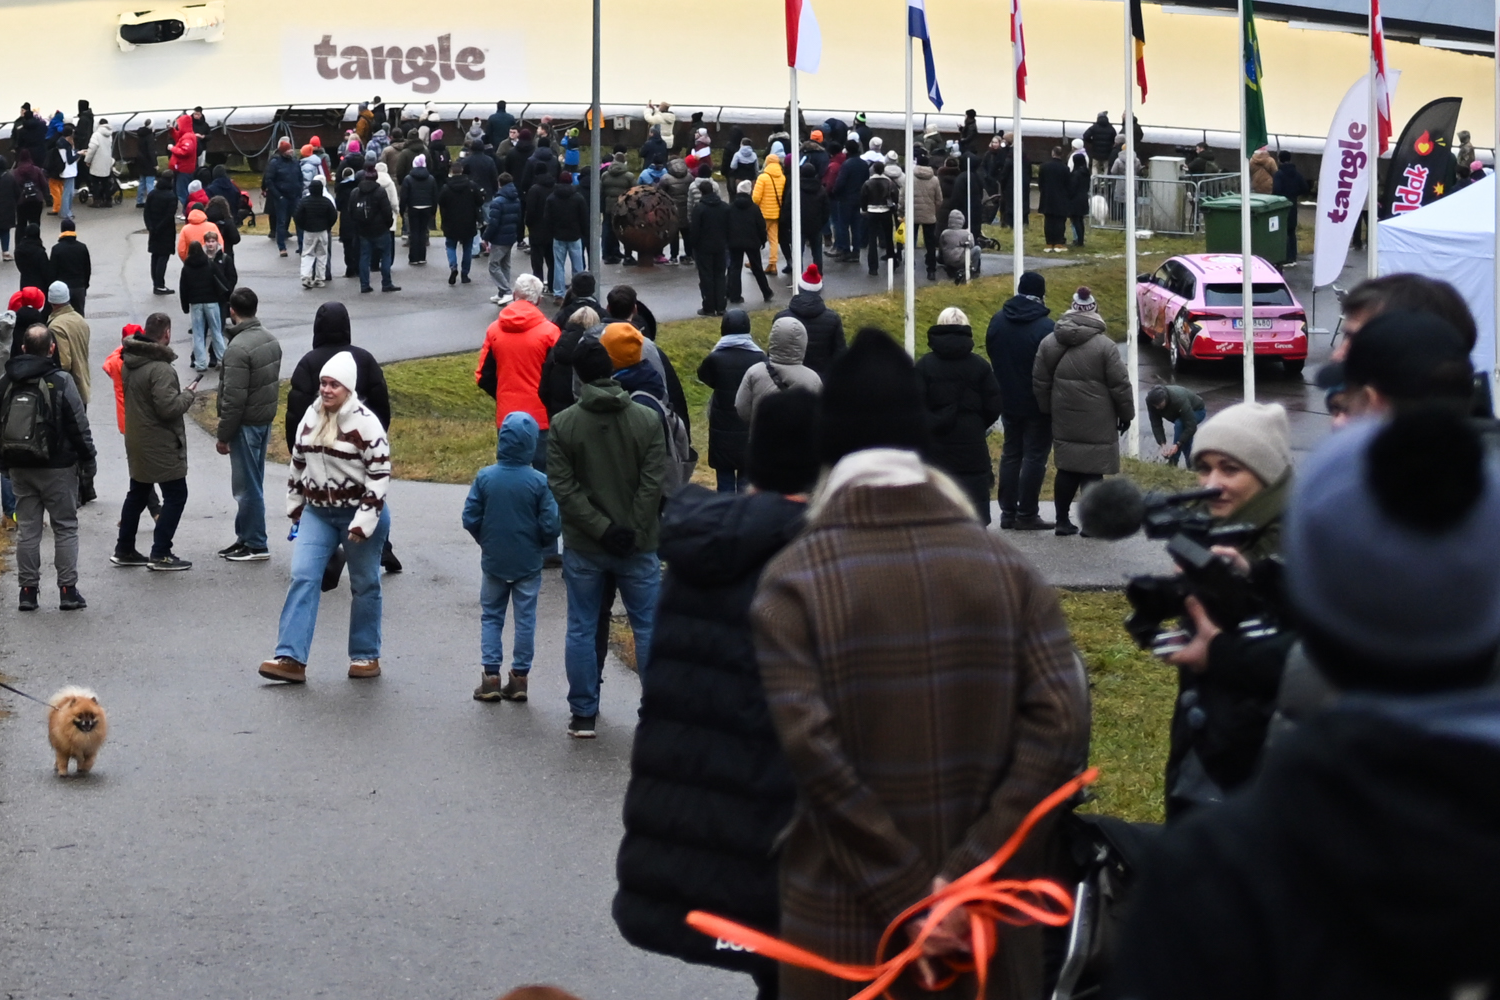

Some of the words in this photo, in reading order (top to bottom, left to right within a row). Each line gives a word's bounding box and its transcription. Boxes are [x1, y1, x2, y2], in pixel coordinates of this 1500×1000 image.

[314, 33, 486, 94] tangle
[1327, 121, 1368, 224] tangle
[1392, 164, 1429, 215] ldak
